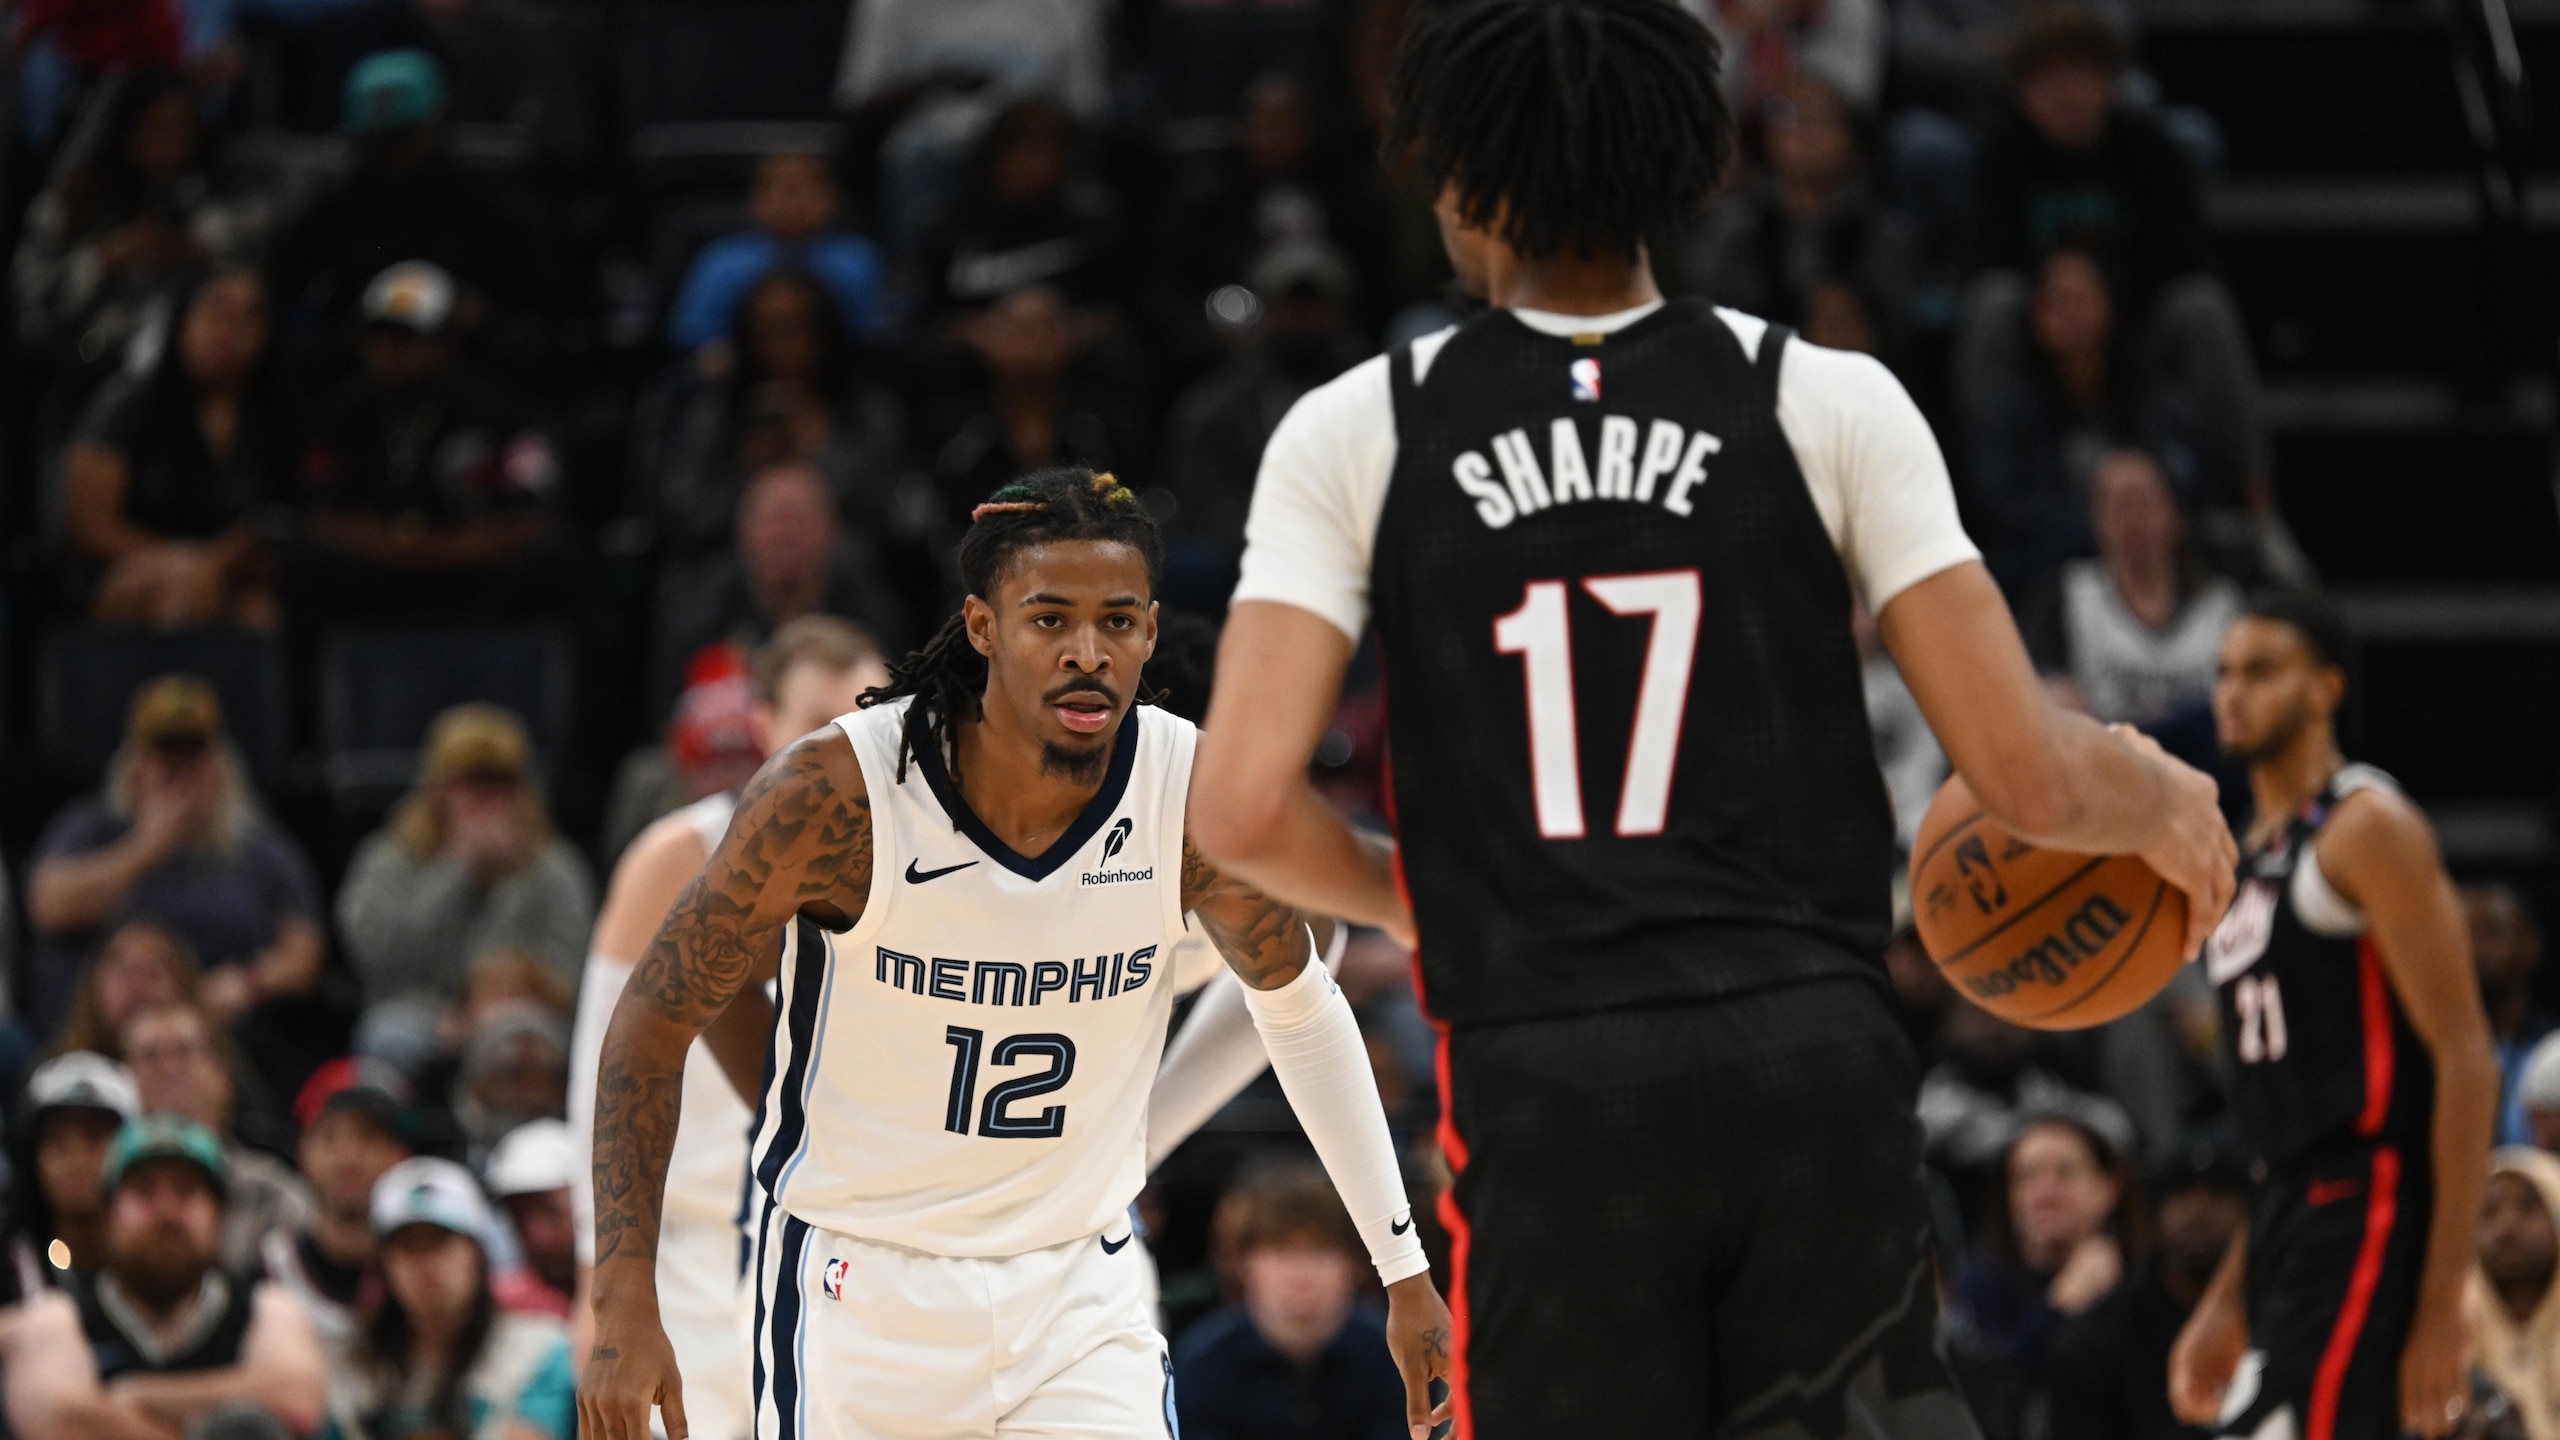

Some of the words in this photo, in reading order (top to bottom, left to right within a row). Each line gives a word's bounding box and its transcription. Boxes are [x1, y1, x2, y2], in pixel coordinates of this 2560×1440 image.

[1452, 414, 1722, 529] SHARPE
[1491, 566, 1705, 840] 17
[1082, 866, 1153, 886] Robinhood
[876, 944, 1158, 1007] MEMPHIS
[1964, 893, 2132, 1000] Wilson
[2235, 973, 2288, 1064] 21
[945, 1024, 1076, 1139] 12
